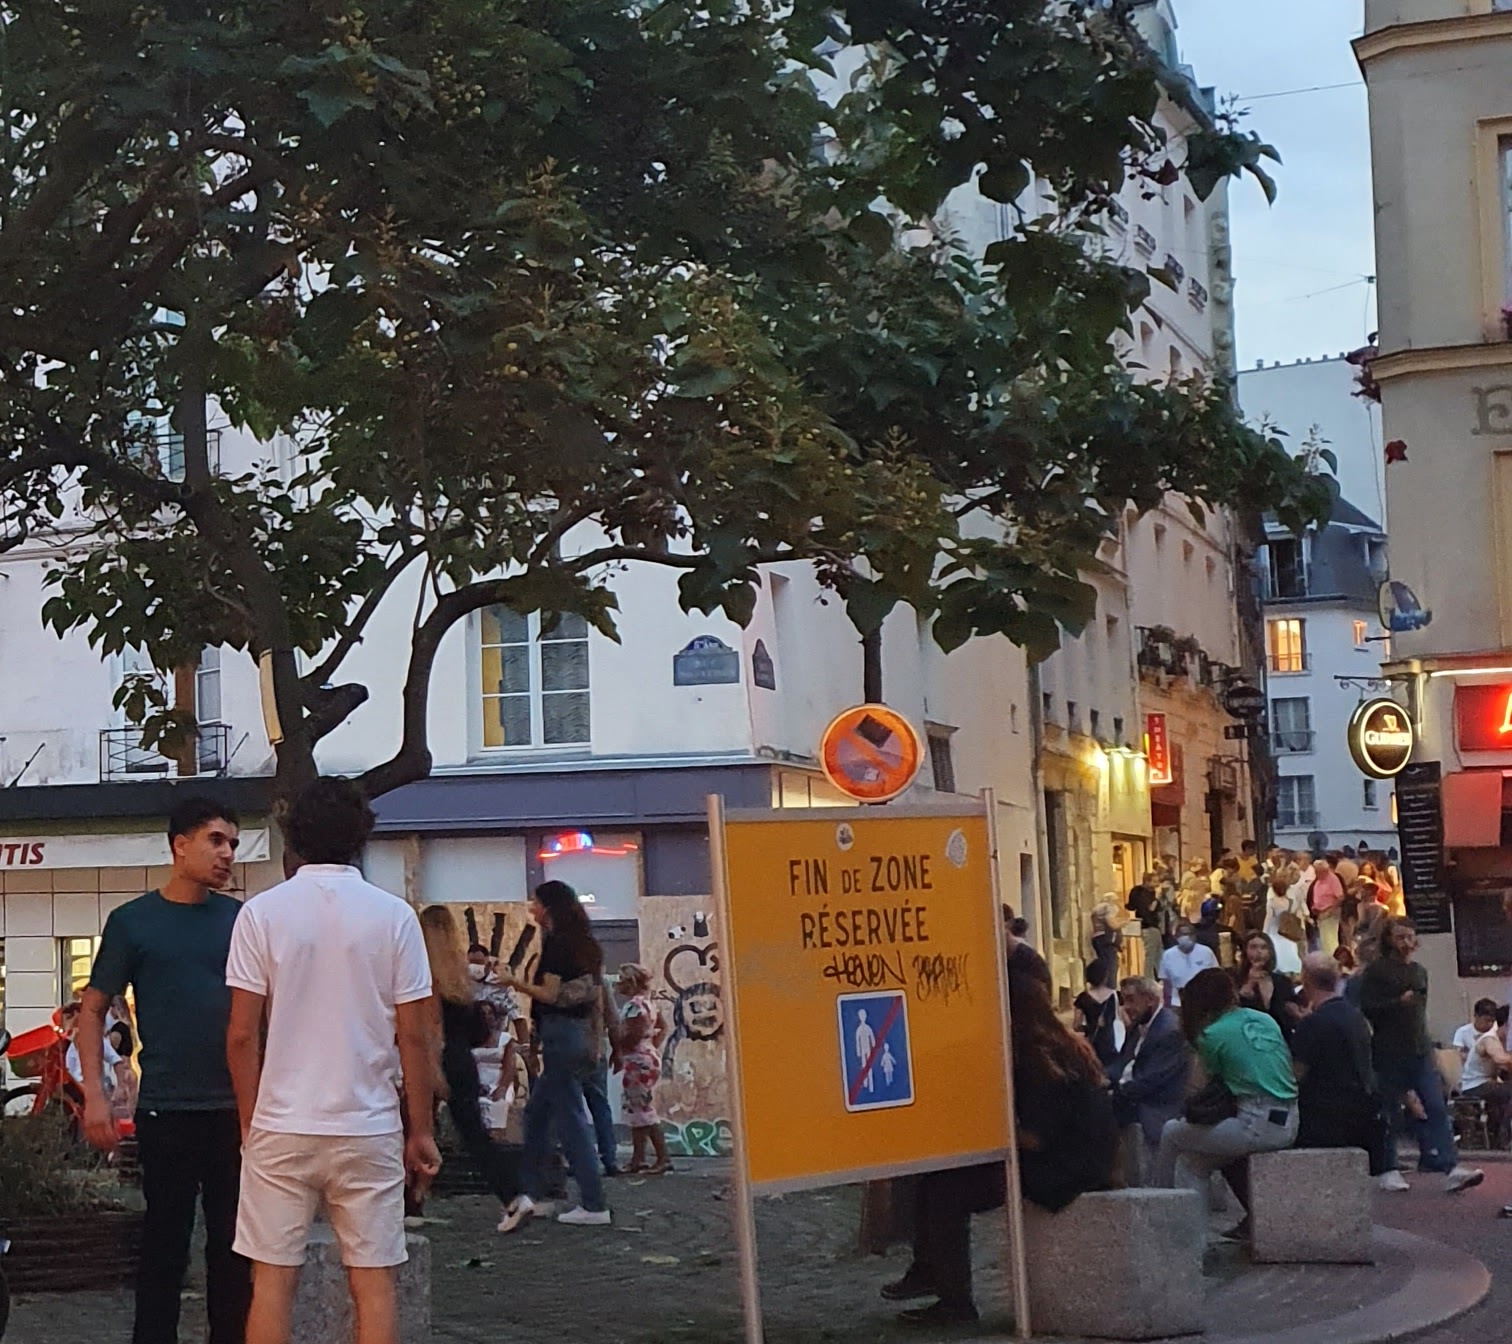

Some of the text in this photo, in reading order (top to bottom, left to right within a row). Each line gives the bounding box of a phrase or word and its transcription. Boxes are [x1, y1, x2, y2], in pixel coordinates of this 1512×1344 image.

[790, 855, 933, 896] FIN DE ZONE
[801, 899, 929, 950] RÉSERVÉE
